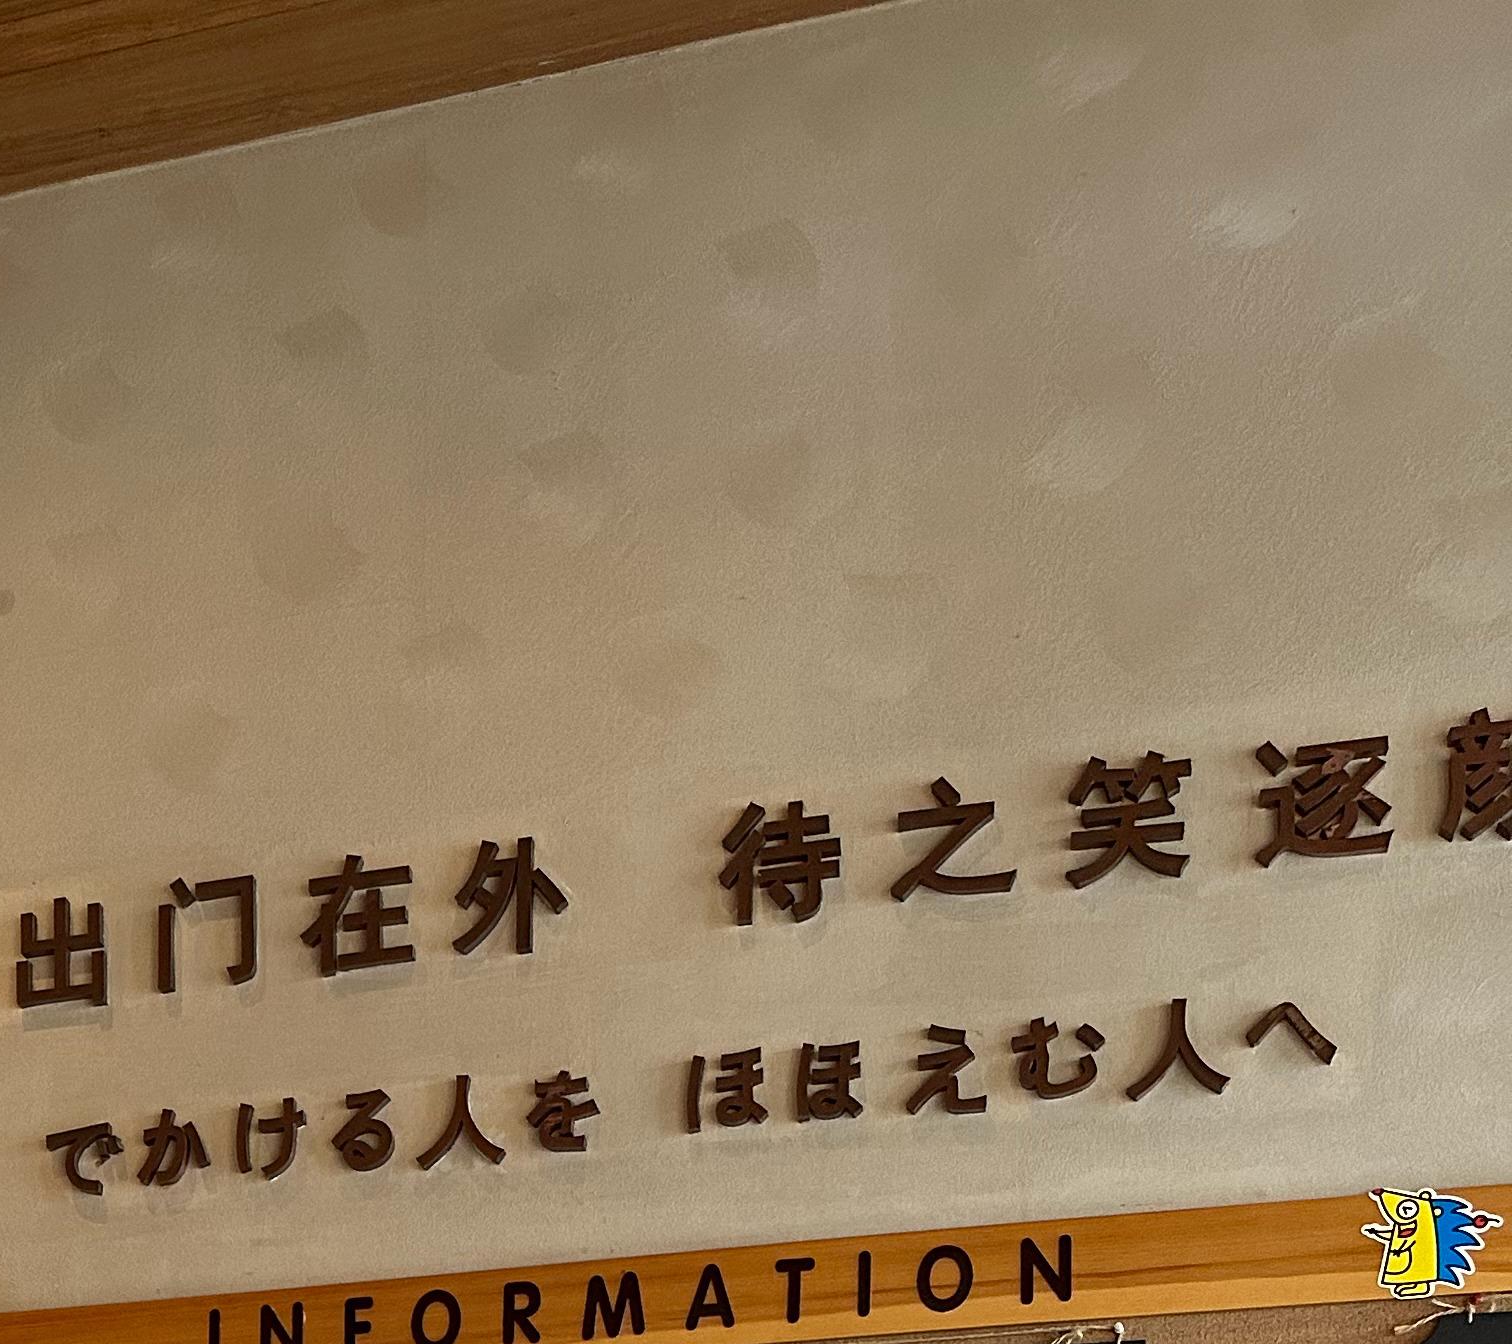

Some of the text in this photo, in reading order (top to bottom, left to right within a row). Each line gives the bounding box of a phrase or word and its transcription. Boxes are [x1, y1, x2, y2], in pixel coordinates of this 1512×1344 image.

[45, 997, 1338, 1195] でかける人を ほほえむ人へ
